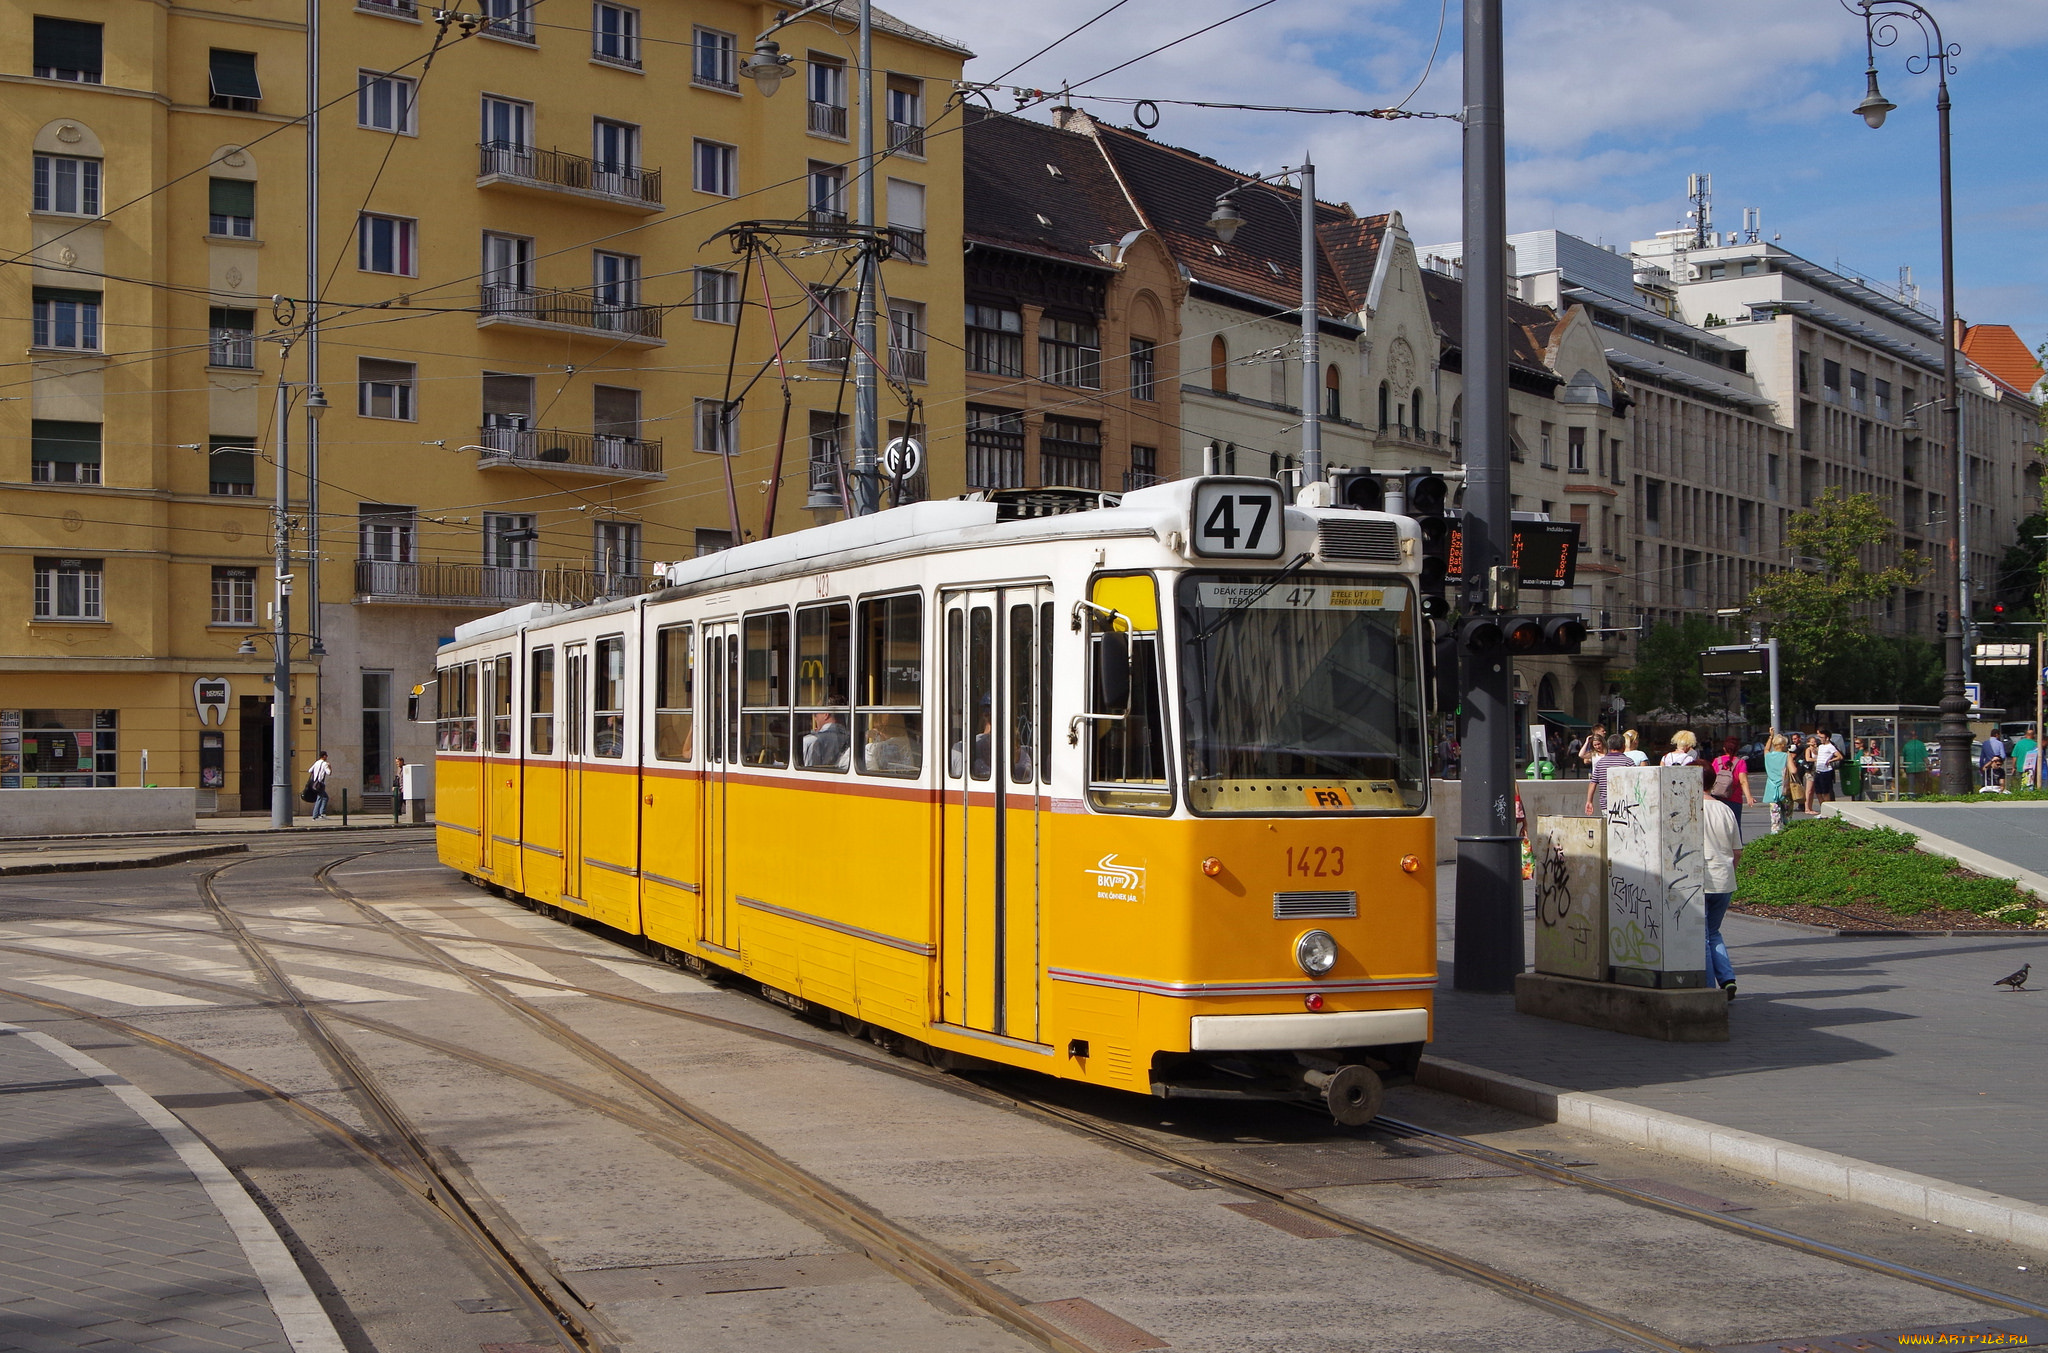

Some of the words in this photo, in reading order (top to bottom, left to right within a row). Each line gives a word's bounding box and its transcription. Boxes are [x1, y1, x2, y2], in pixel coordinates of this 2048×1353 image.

[1203, 495, 1272, 550] 47
[815, 573, 830, 599] 1423
[1213, 586, 1237, 596] DEÁK
[1285, 588, 1316, 607] 47
[1286, 846, 1345, 878] 1423
